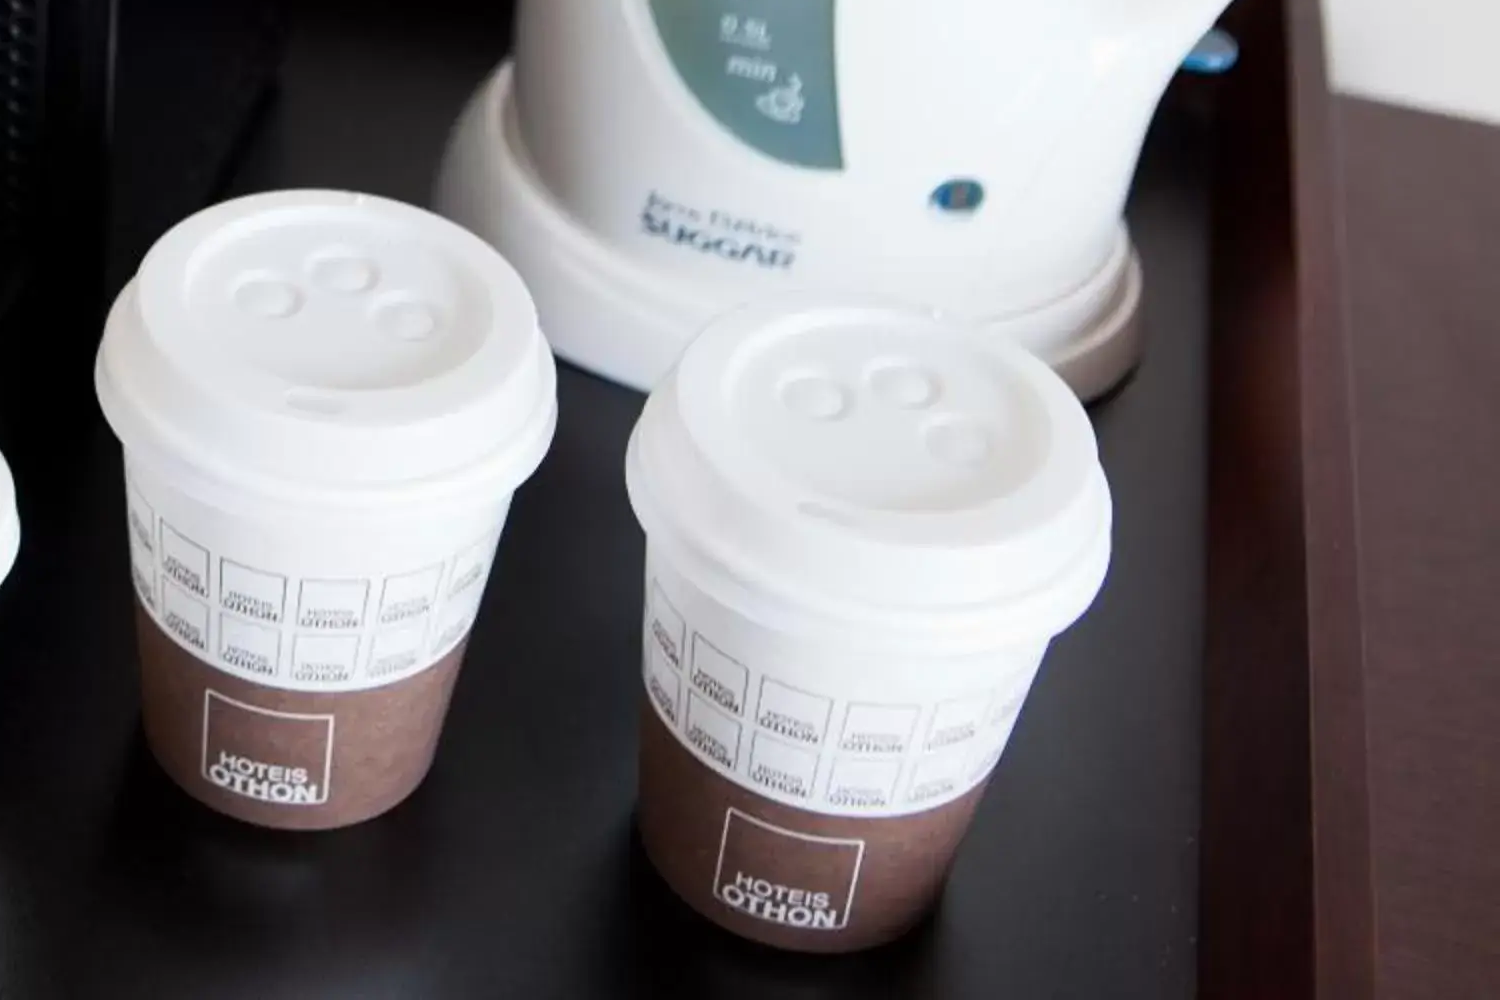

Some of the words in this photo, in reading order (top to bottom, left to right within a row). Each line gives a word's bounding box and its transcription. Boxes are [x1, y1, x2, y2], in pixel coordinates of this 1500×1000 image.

[726, 55, 777, 82] min
[209, 764, 317, 803] OTHON
[219, 750, 308, 784] HOTEIS
[722, 885, 837, 928] OTHON
[735, 871, 830, 909] HOTEIS
